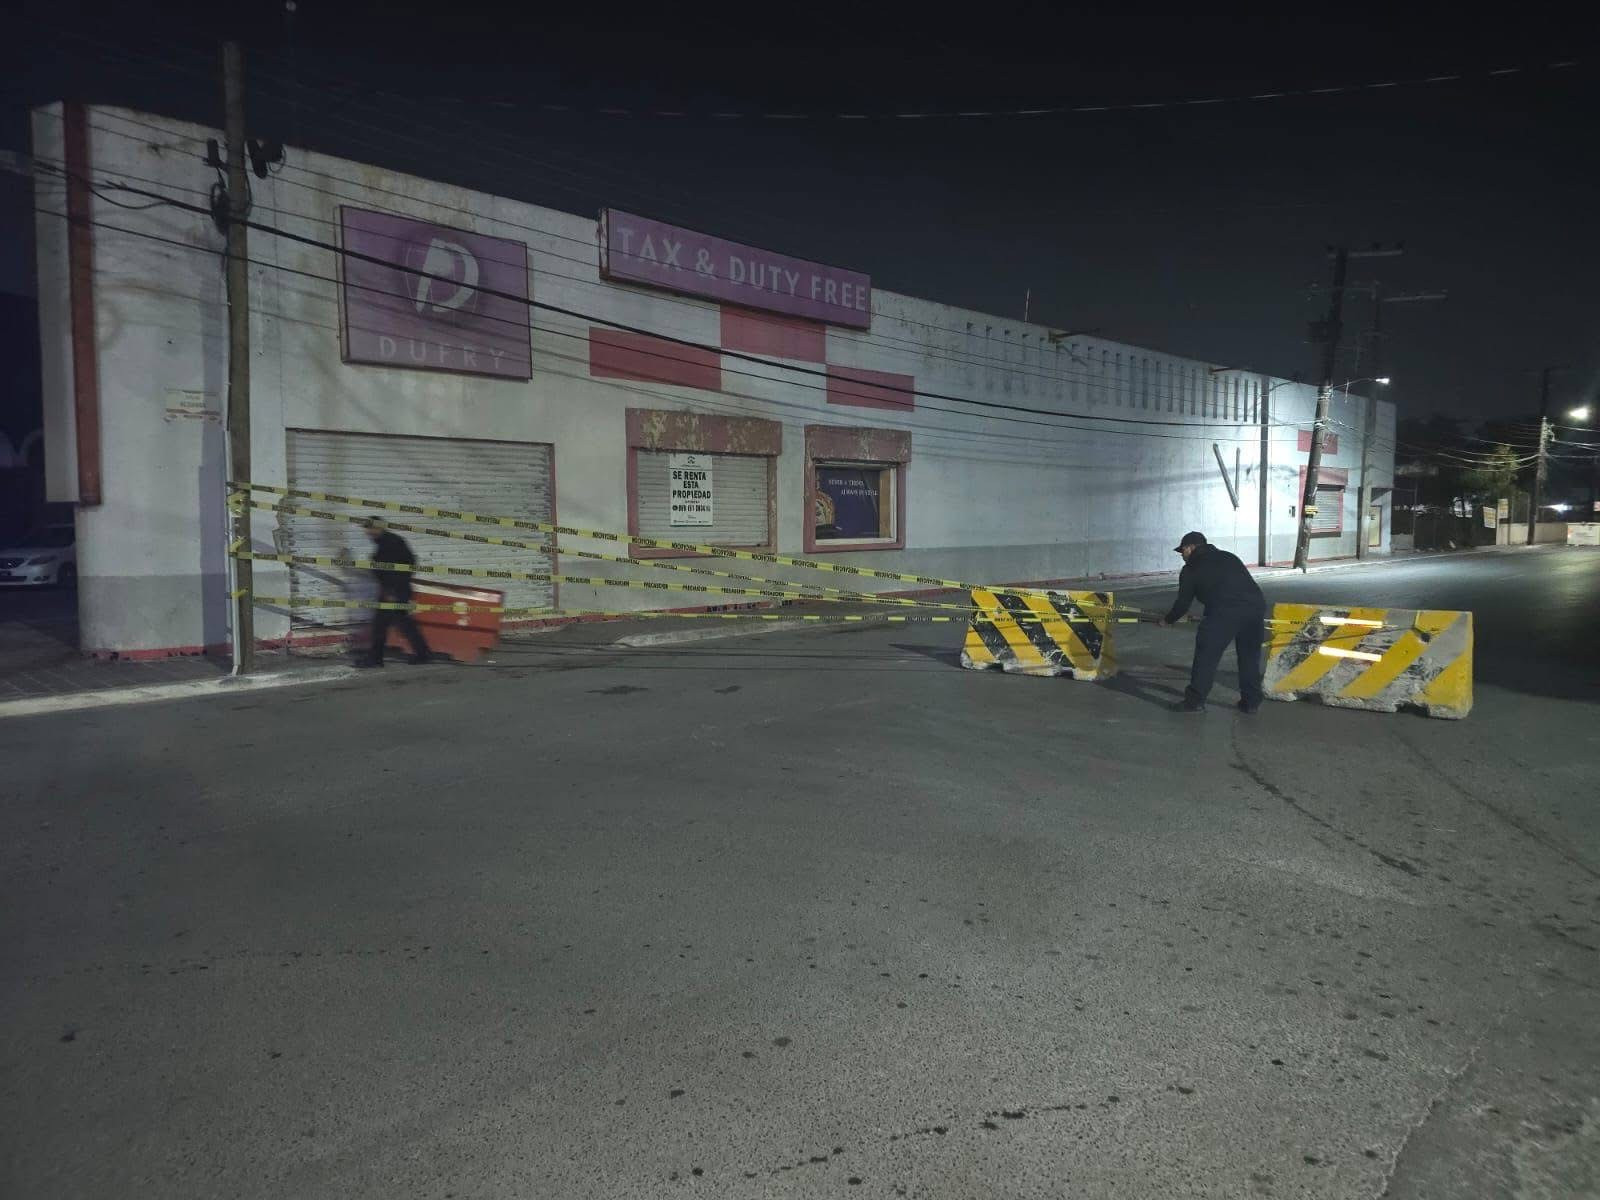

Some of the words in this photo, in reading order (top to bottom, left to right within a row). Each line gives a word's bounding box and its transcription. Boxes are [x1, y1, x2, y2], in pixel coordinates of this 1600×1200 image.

[616, 227, 683, 272] TAX
[695, 248, 716, 280] &
[730, 255, 800, 297] DUTY
[811, 275, 867, 311] FREE
[379, 335, 504, 369] DUFRY
[672, 470, 682, 480] SE
[684, 471, 706, 480] RENTA
[684, 481, 699, 489] ESTA
[672, 490, 711, 499] PROPIEDAD
